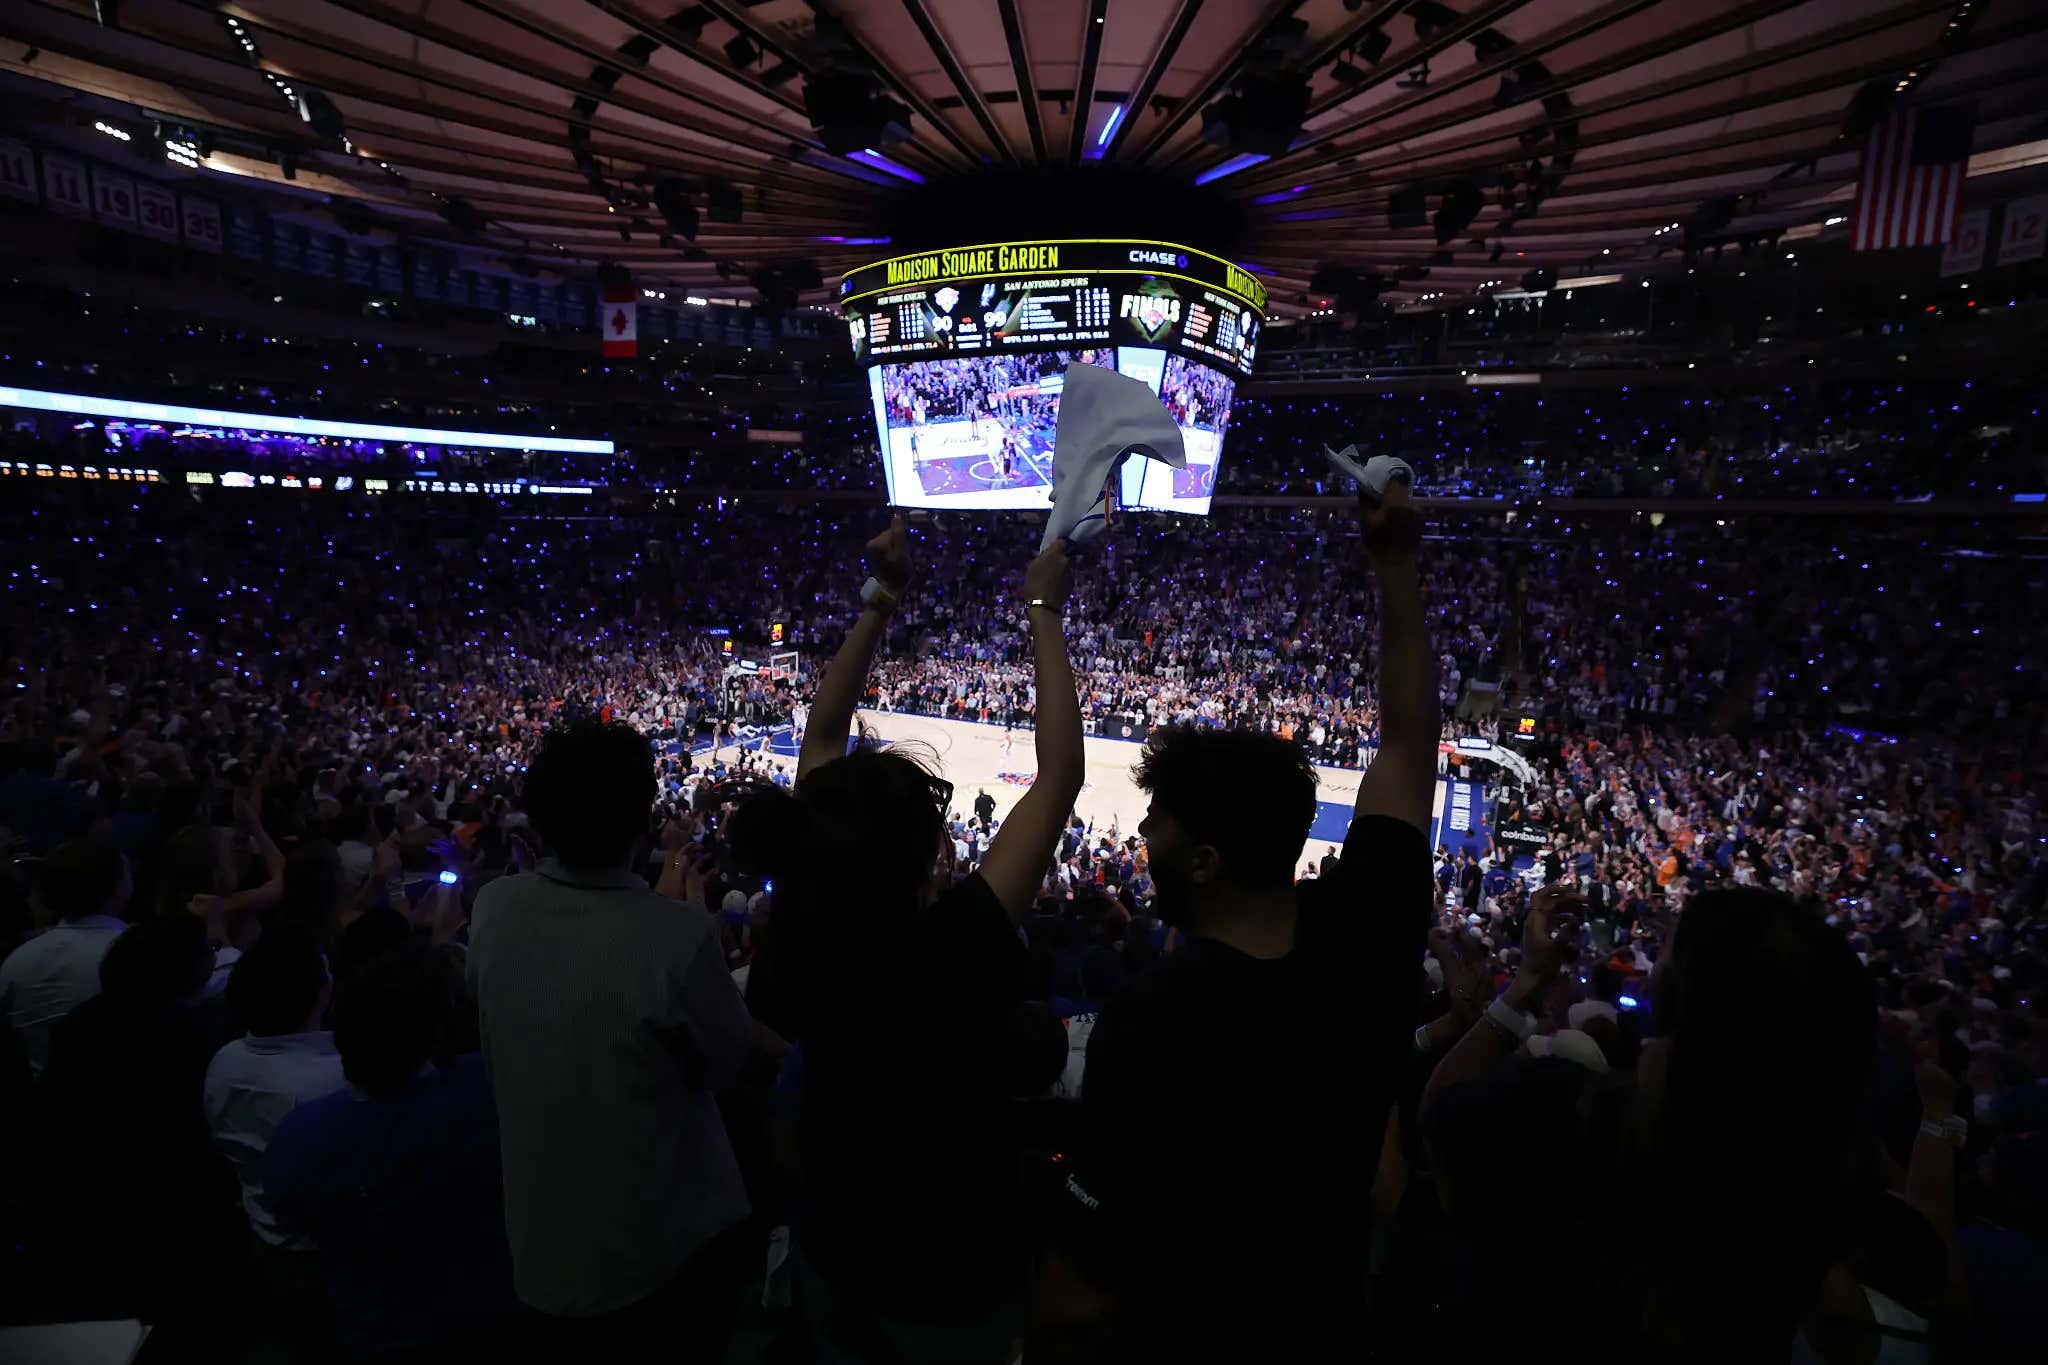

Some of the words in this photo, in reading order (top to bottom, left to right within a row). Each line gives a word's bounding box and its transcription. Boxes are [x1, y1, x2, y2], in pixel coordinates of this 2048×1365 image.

[101, 186, 129, 217] 19
[142, 199, 173, 229] 30
[189, 212, 218, 241] 35
[887, 256, 939, 284] MADISON
[942, 250, 994, 276] SQUARE
[999, 245, 1059, 271] GARDEN
[1129, 250, 1176, 266] CHASE
[1004, 281, 1020, 291] SAN
[1021, 279, 1060, 290] ANTONIO
[1060, 277, 1089, 288] SPURS
[984, 311, 1007, 328] 99
[1120, 294, 1180, 323] FINALS
[932, 315, 953, 332] 90
[1501, 829, 1547, 844] coinbase
